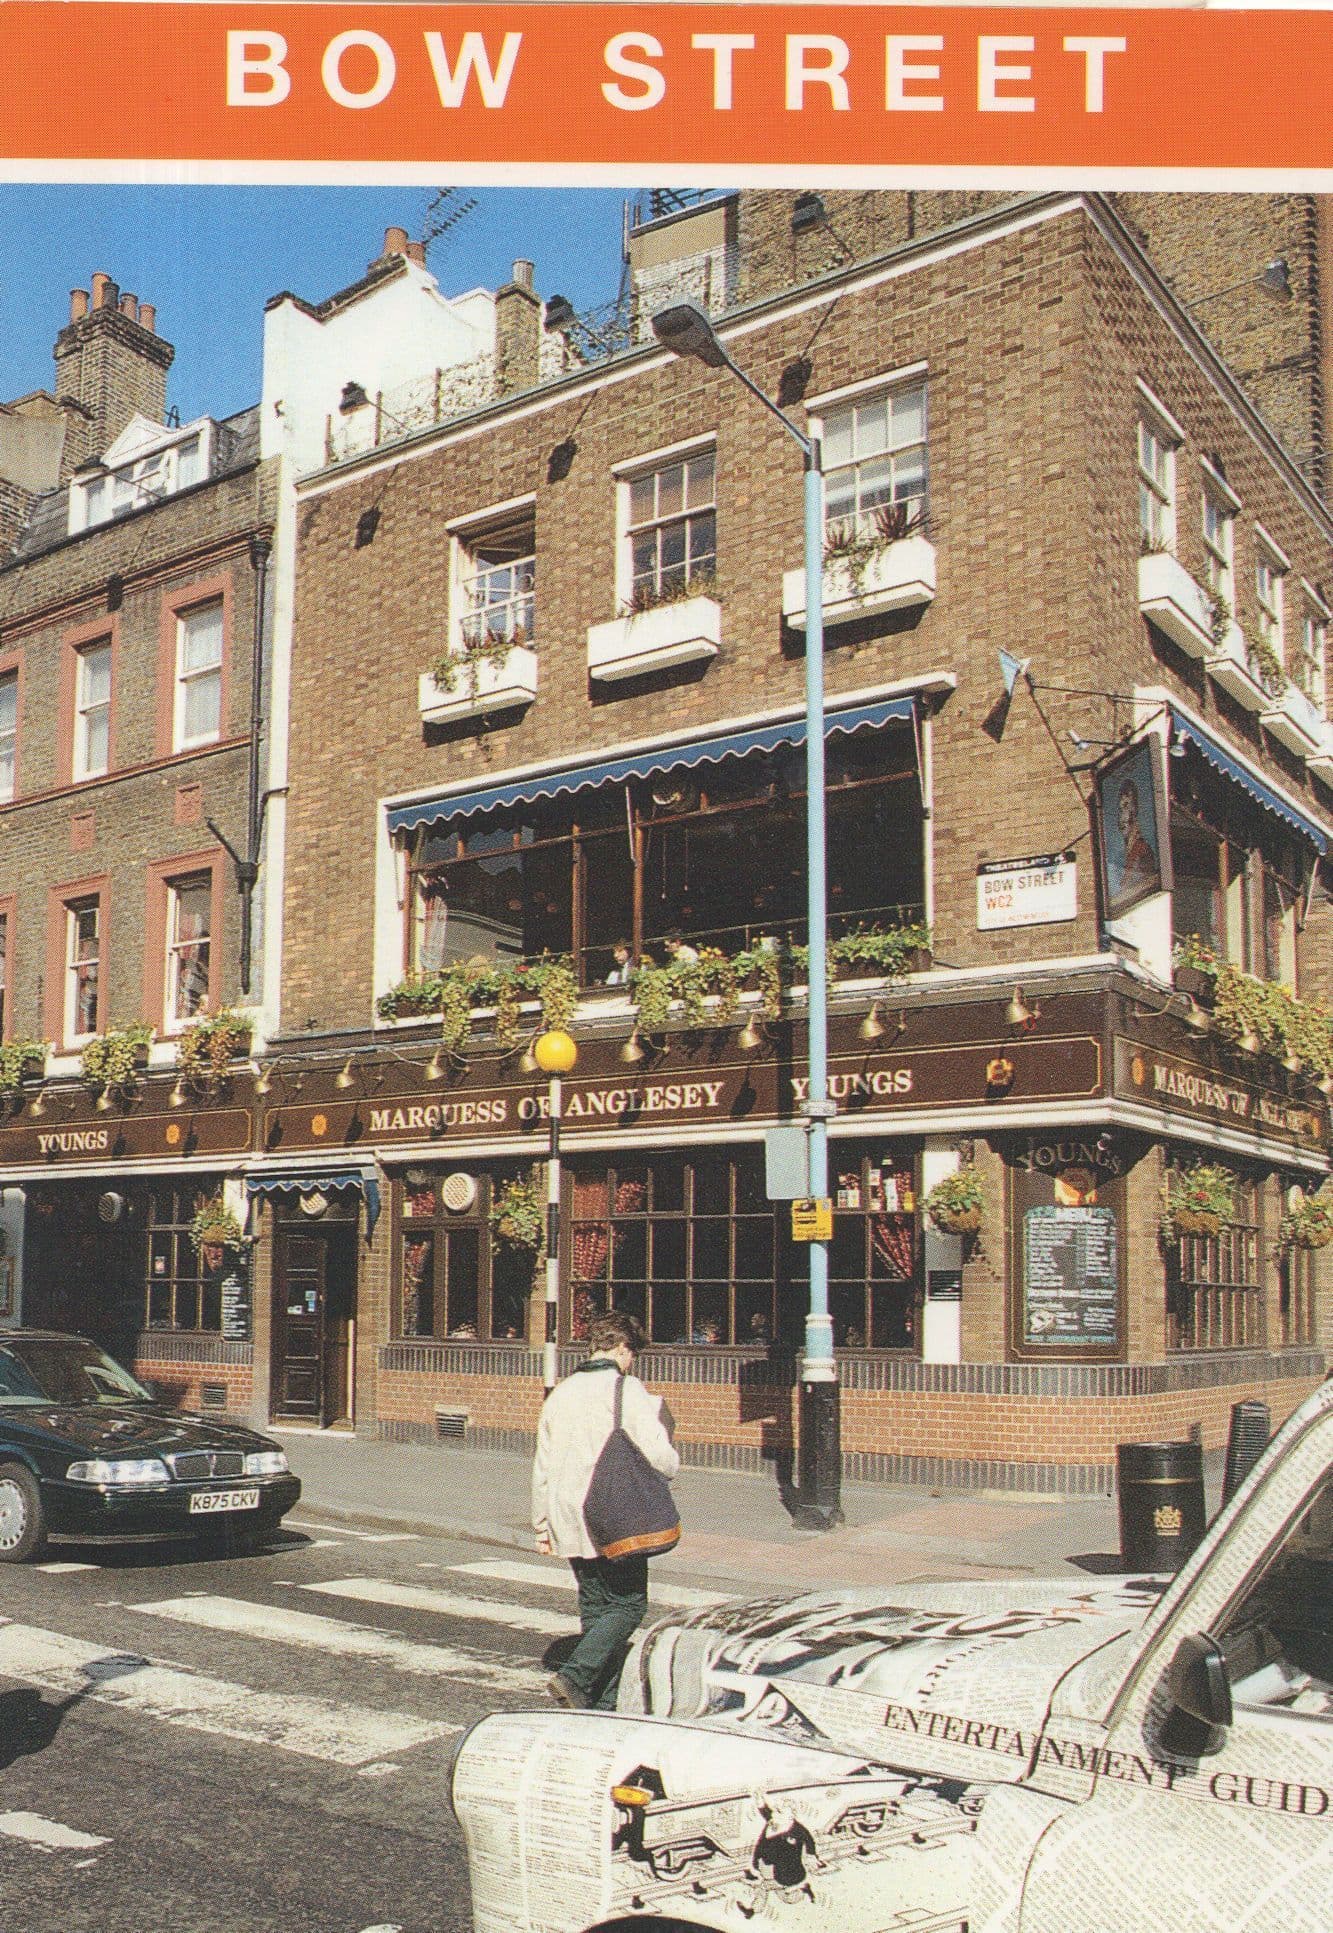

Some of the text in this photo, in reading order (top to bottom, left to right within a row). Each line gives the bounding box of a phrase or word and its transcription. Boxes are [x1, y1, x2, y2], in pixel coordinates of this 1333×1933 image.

[984, 871, 1064, 894] BOW STREET
[986, 894, 1013, 911] WC2
[790, 1068, 913, 1100] YUNGS
[1153, 1064, 1231, 1112] MARQUESS
[368, 1100, 507, 1132] MARQUESS
[564, 1081, 725, 1117] ANGLESEY
[37, 1130, 109, 1154] YOUNGS
[192, 1491, 257, 1510] K875 CKV
